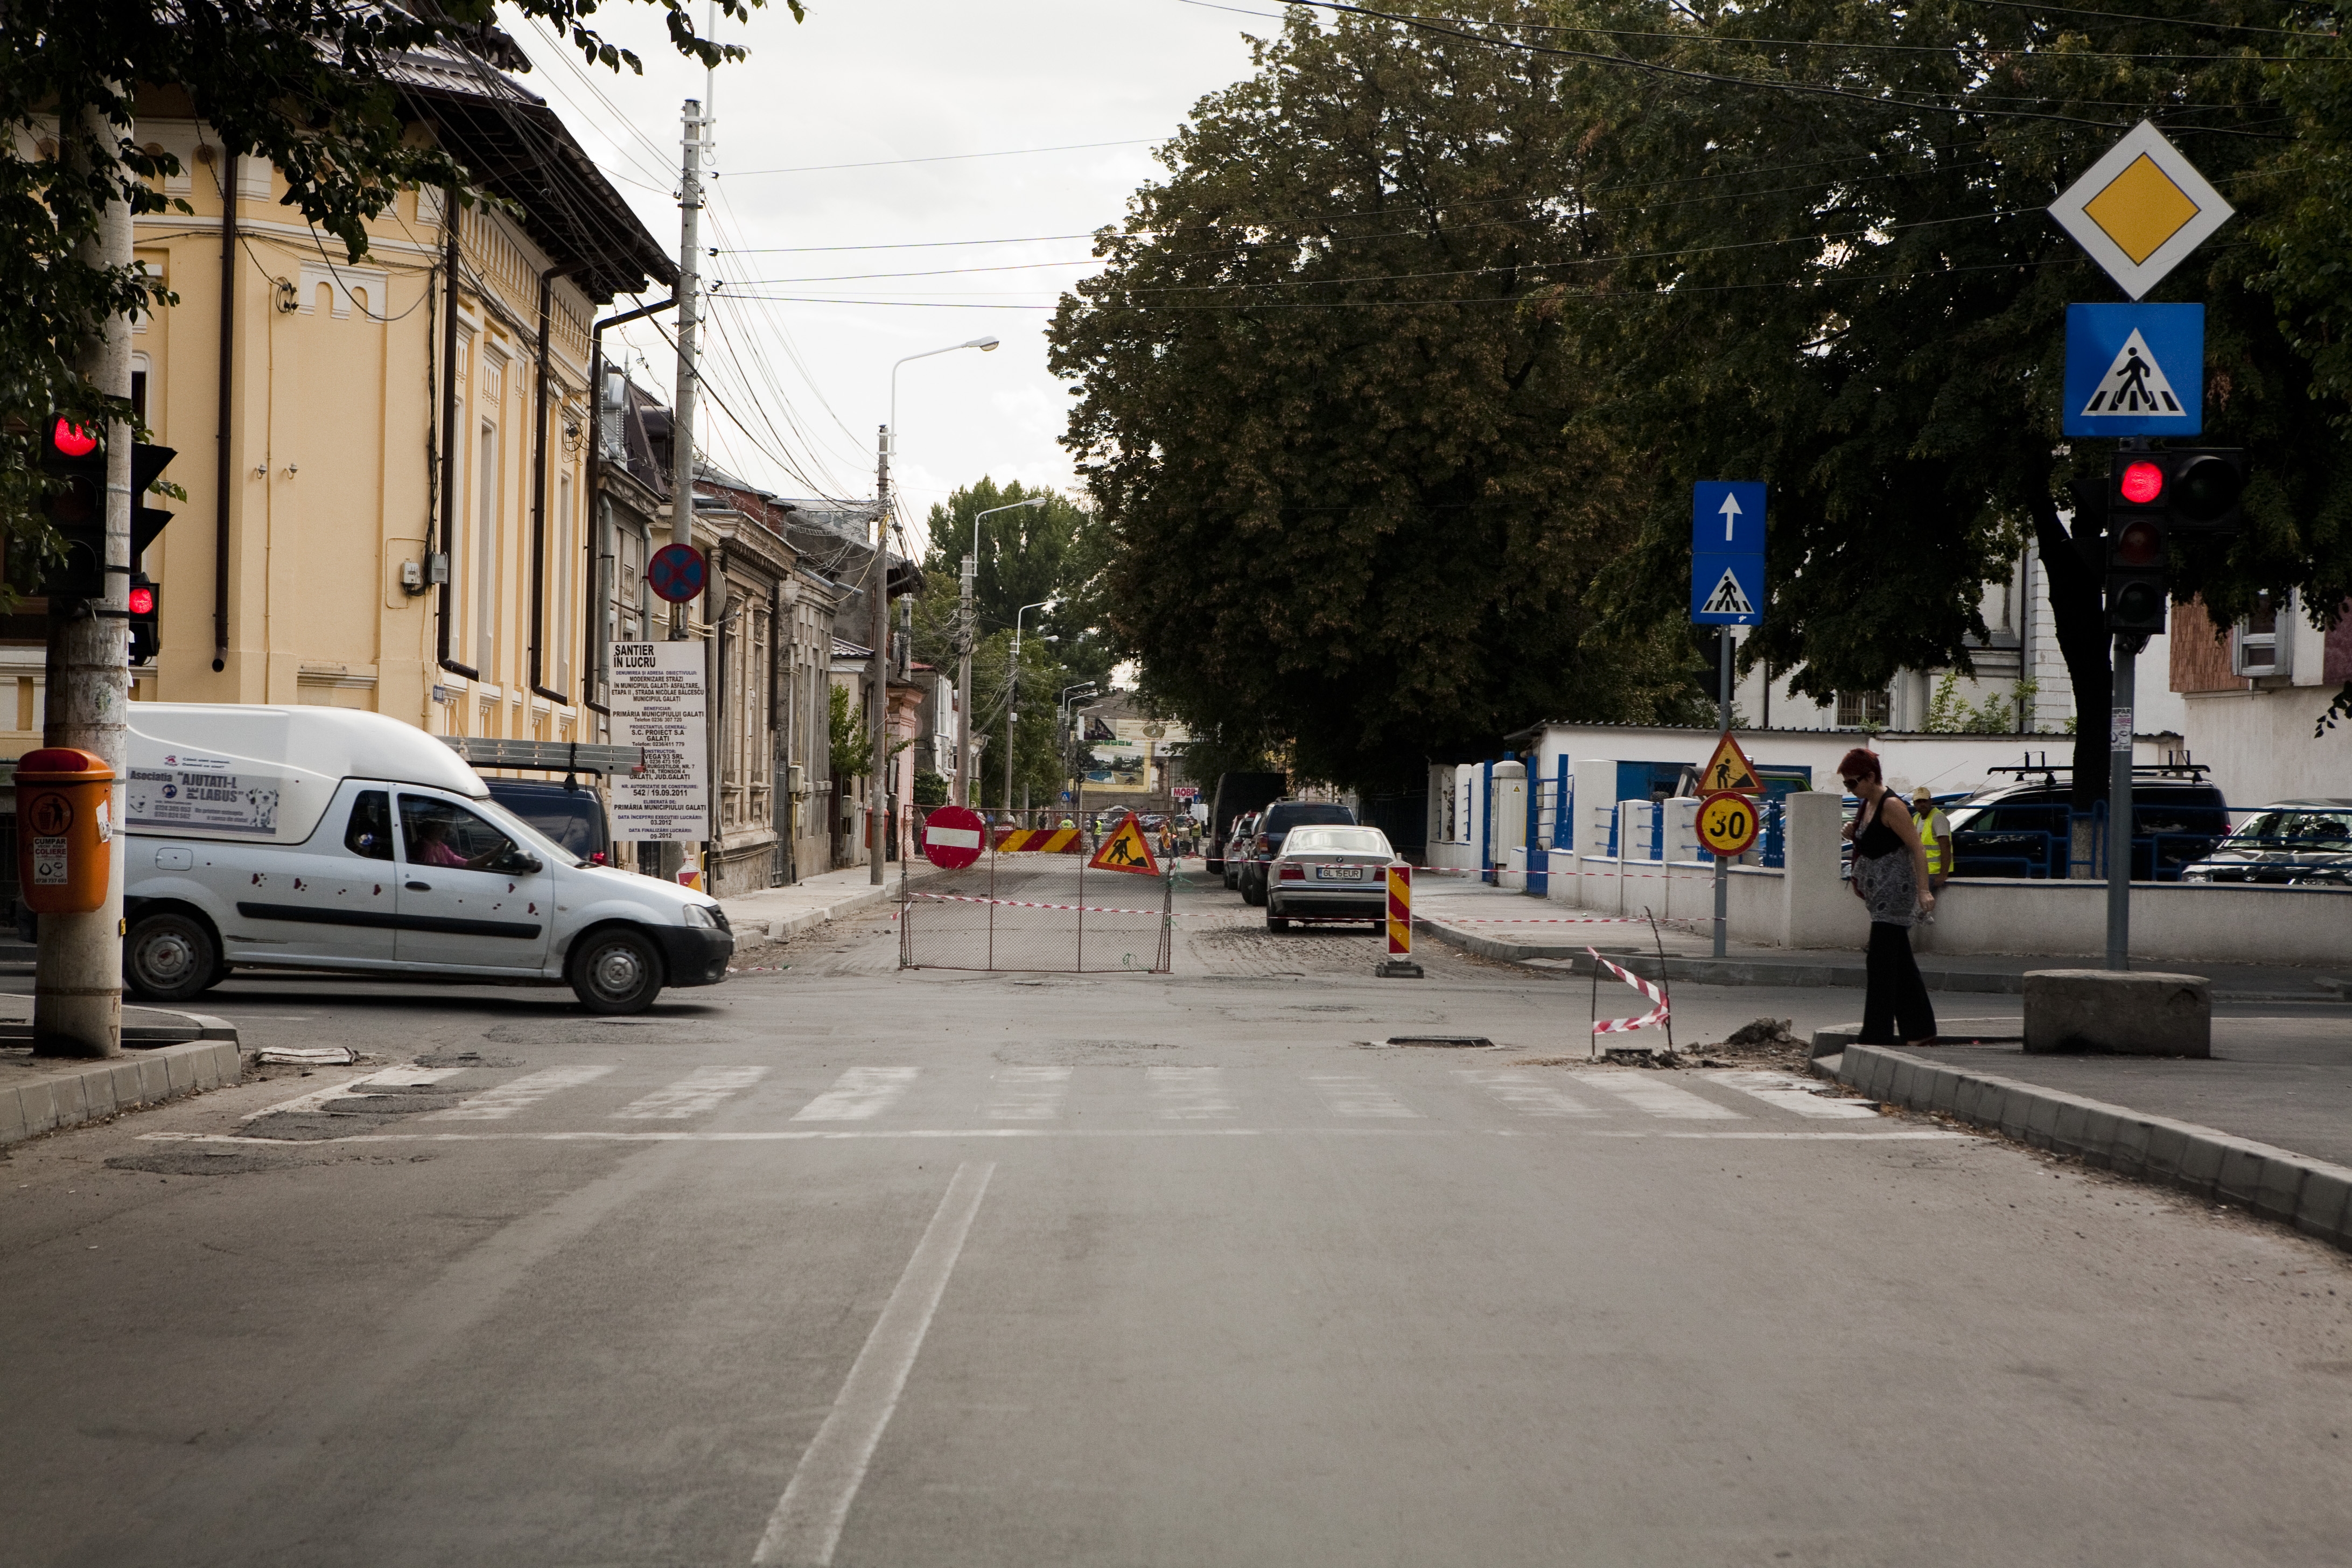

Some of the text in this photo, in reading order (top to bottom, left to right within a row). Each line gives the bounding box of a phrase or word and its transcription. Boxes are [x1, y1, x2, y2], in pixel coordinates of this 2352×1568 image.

[614, 655, 655, 667] ÎN LUCRU
[186, 787, 199, 799] PE
[1710, 810, 1745, 839] 30
